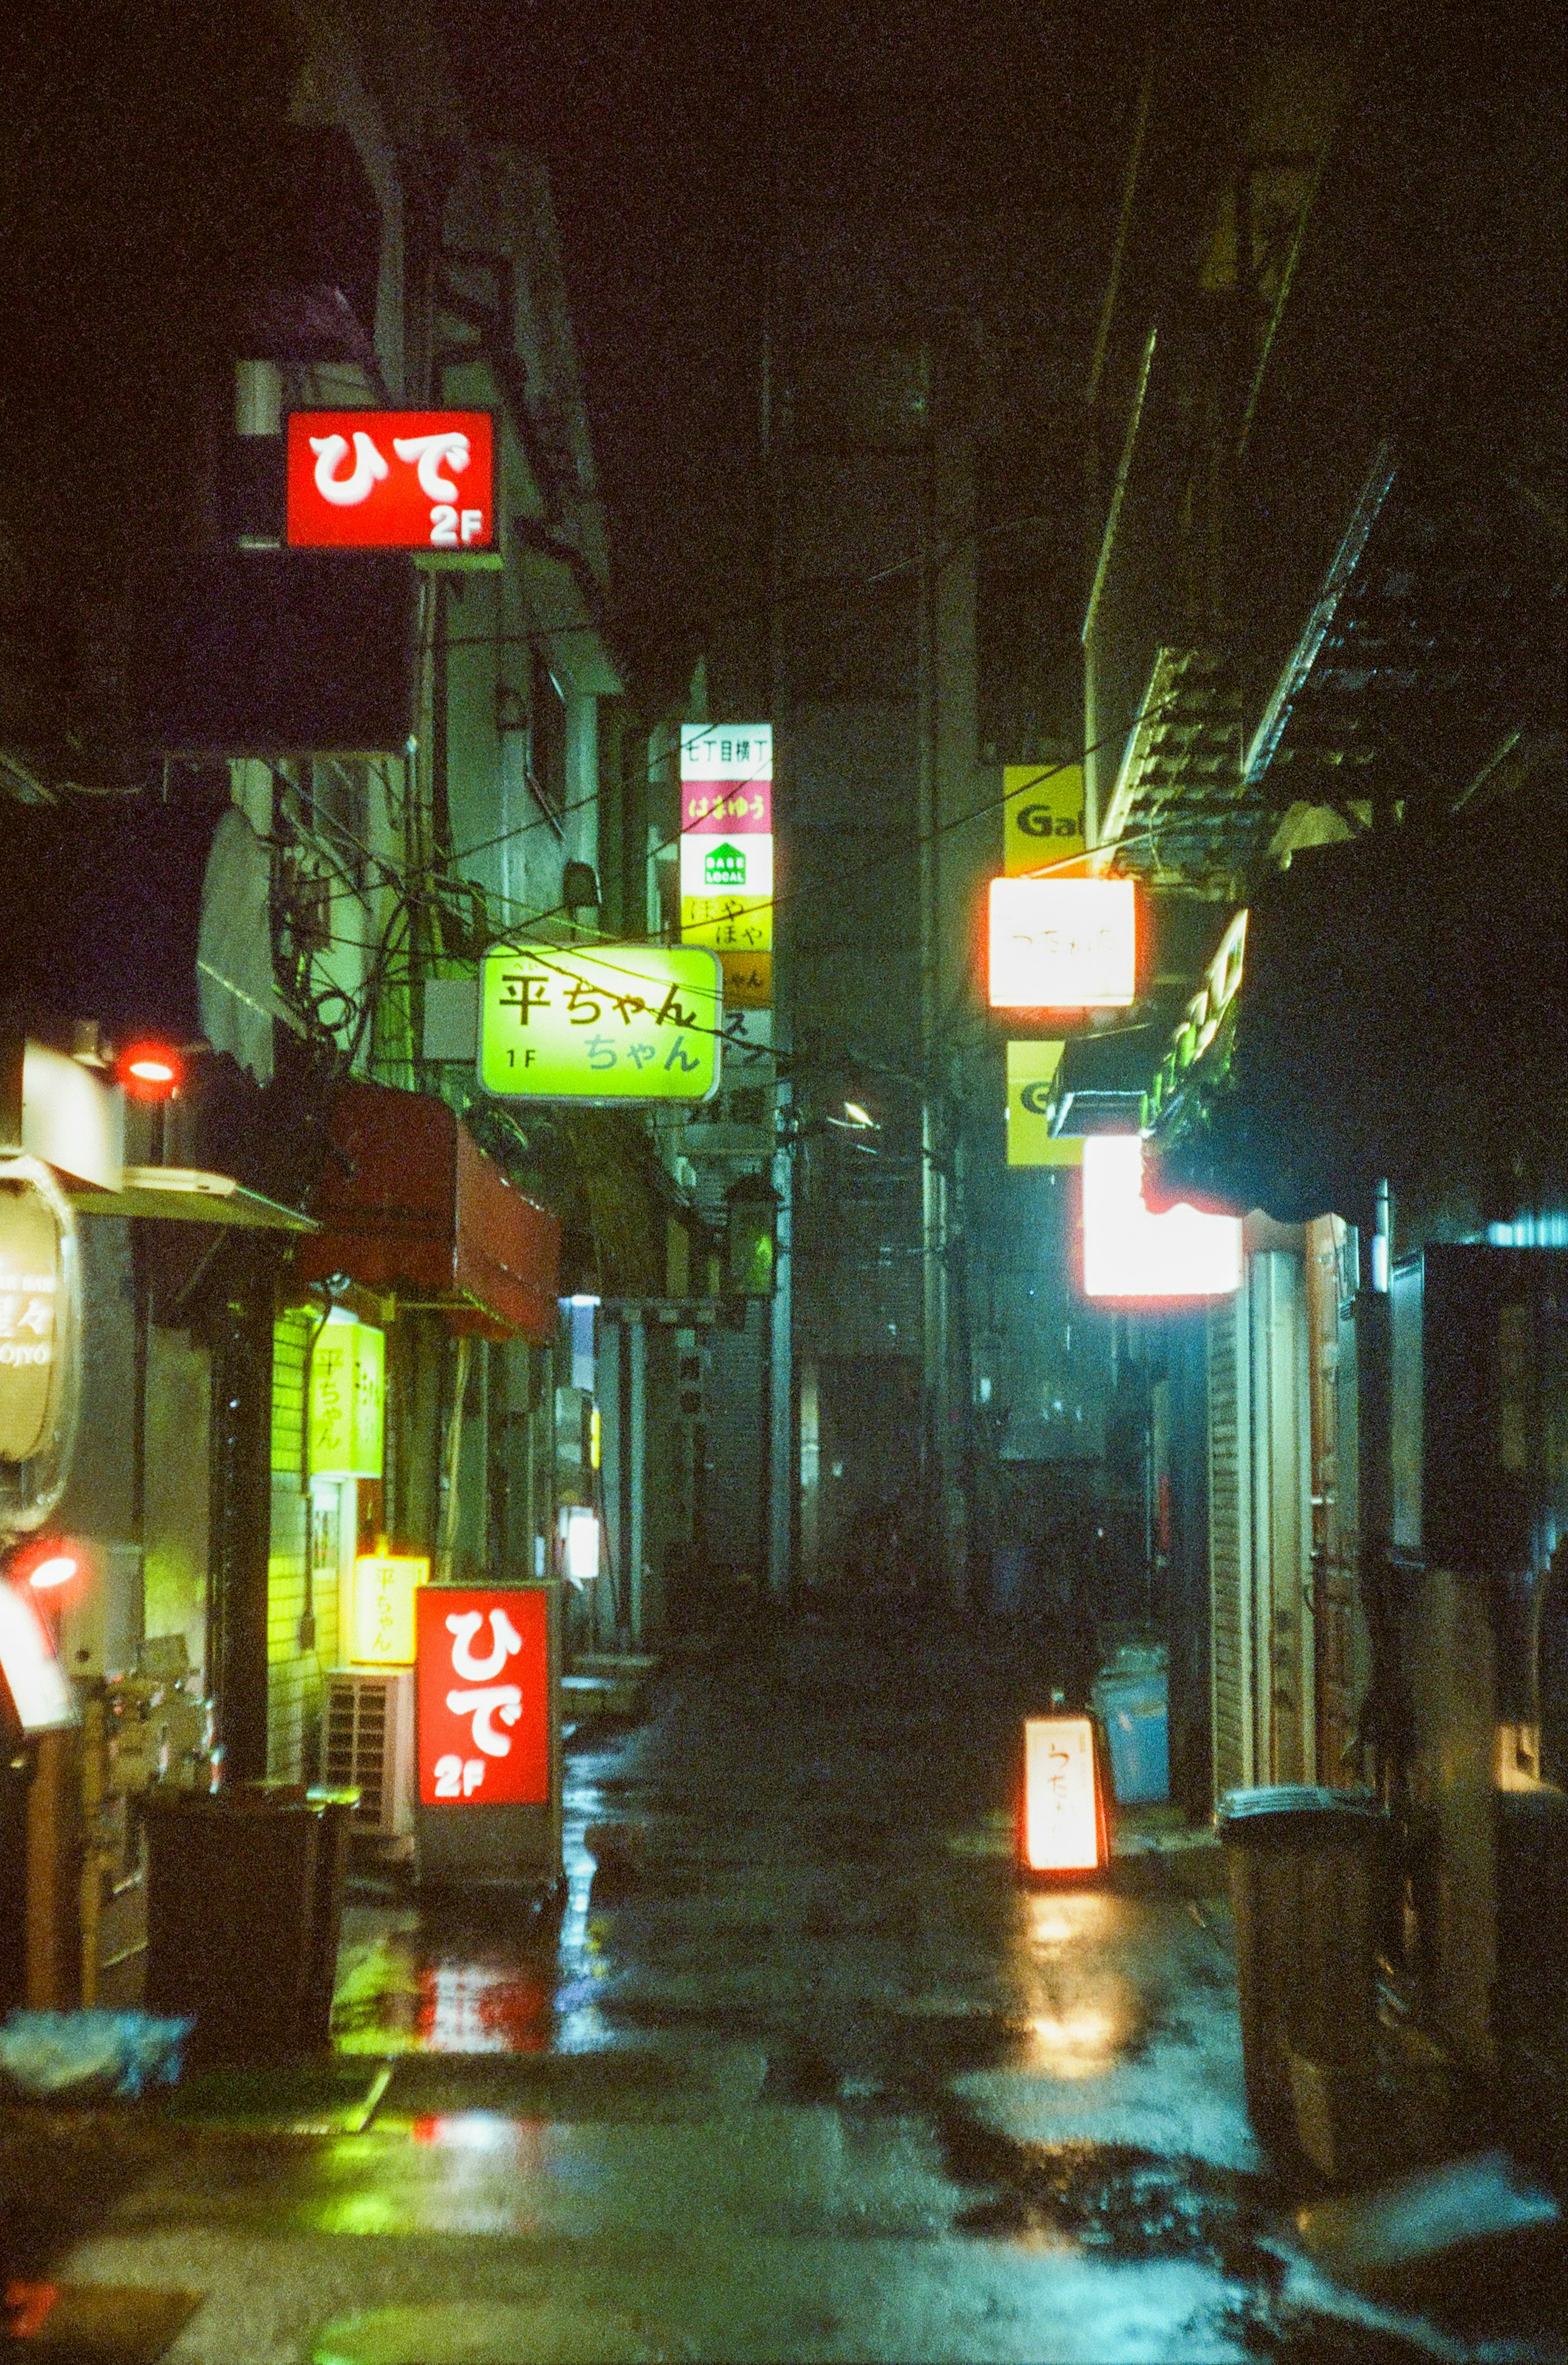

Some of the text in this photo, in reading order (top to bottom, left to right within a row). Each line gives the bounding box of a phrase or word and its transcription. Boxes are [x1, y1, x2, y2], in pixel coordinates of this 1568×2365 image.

[309, 432, 470, 506] ひで
[430, 505, 482, 546] 2F
[685, 740, 768, 762] 七丁目横丁
[688, 795, 764, 821] はまゆう
[706, 871, 745, 883] LOCAL
[716, 925, 763, 945] ほや
[499, 974, 697, 1026] 平ちゃん
[506, 1049, 536, 1068] 1F
[584, 1034, 700, 1072] ちゃん
[316, 1349, 343, 1450] 平ちゃん
[376, 1567, 396, 1652] 平ちゃん
[445, 1608, 522, 1757] ひで
[434, 1754, 486, 1797] 2F
